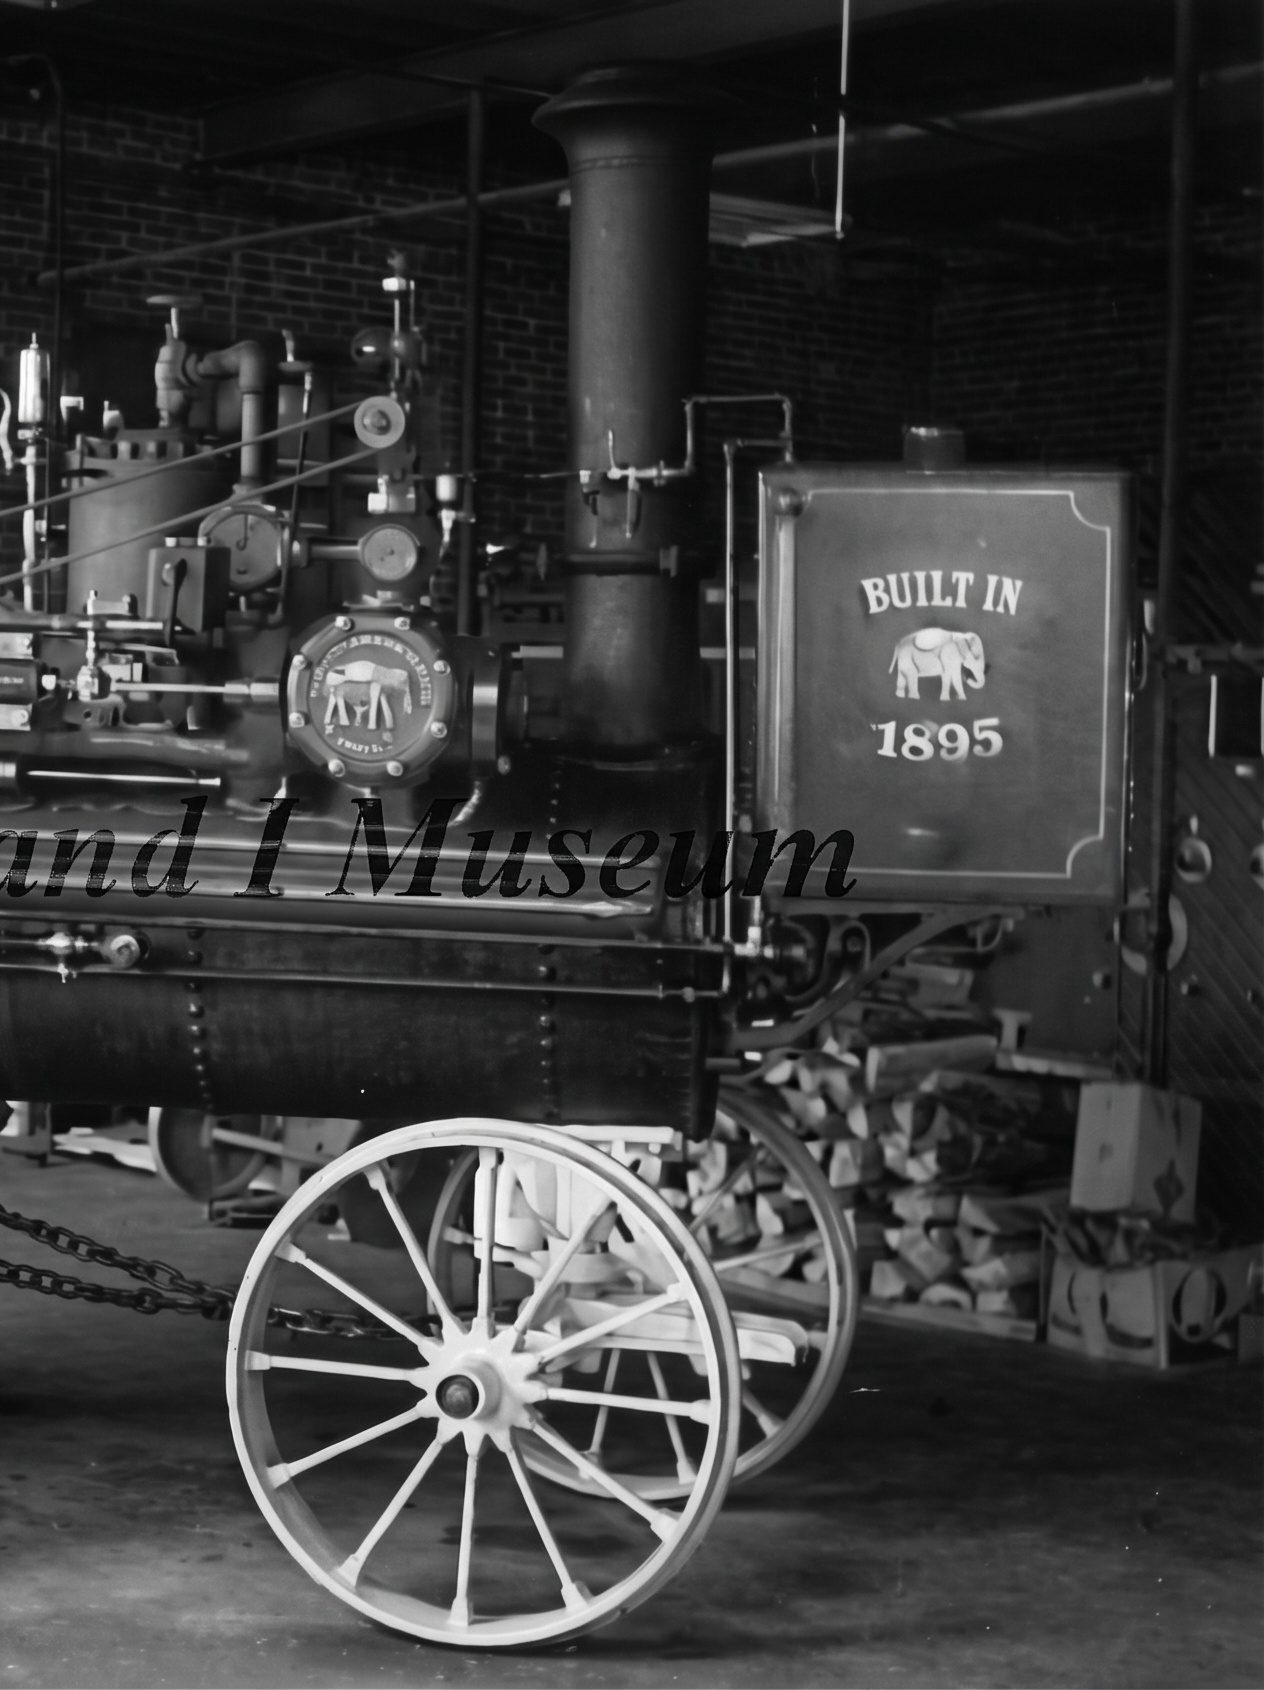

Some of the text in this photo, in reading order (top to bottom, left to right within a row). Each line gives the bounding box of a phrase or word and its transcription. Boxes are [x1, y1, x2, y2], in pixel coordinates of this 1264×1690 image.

[860, 570, 1024, 616] BUILT IN
[871, 717, 1004, 762] 1895
